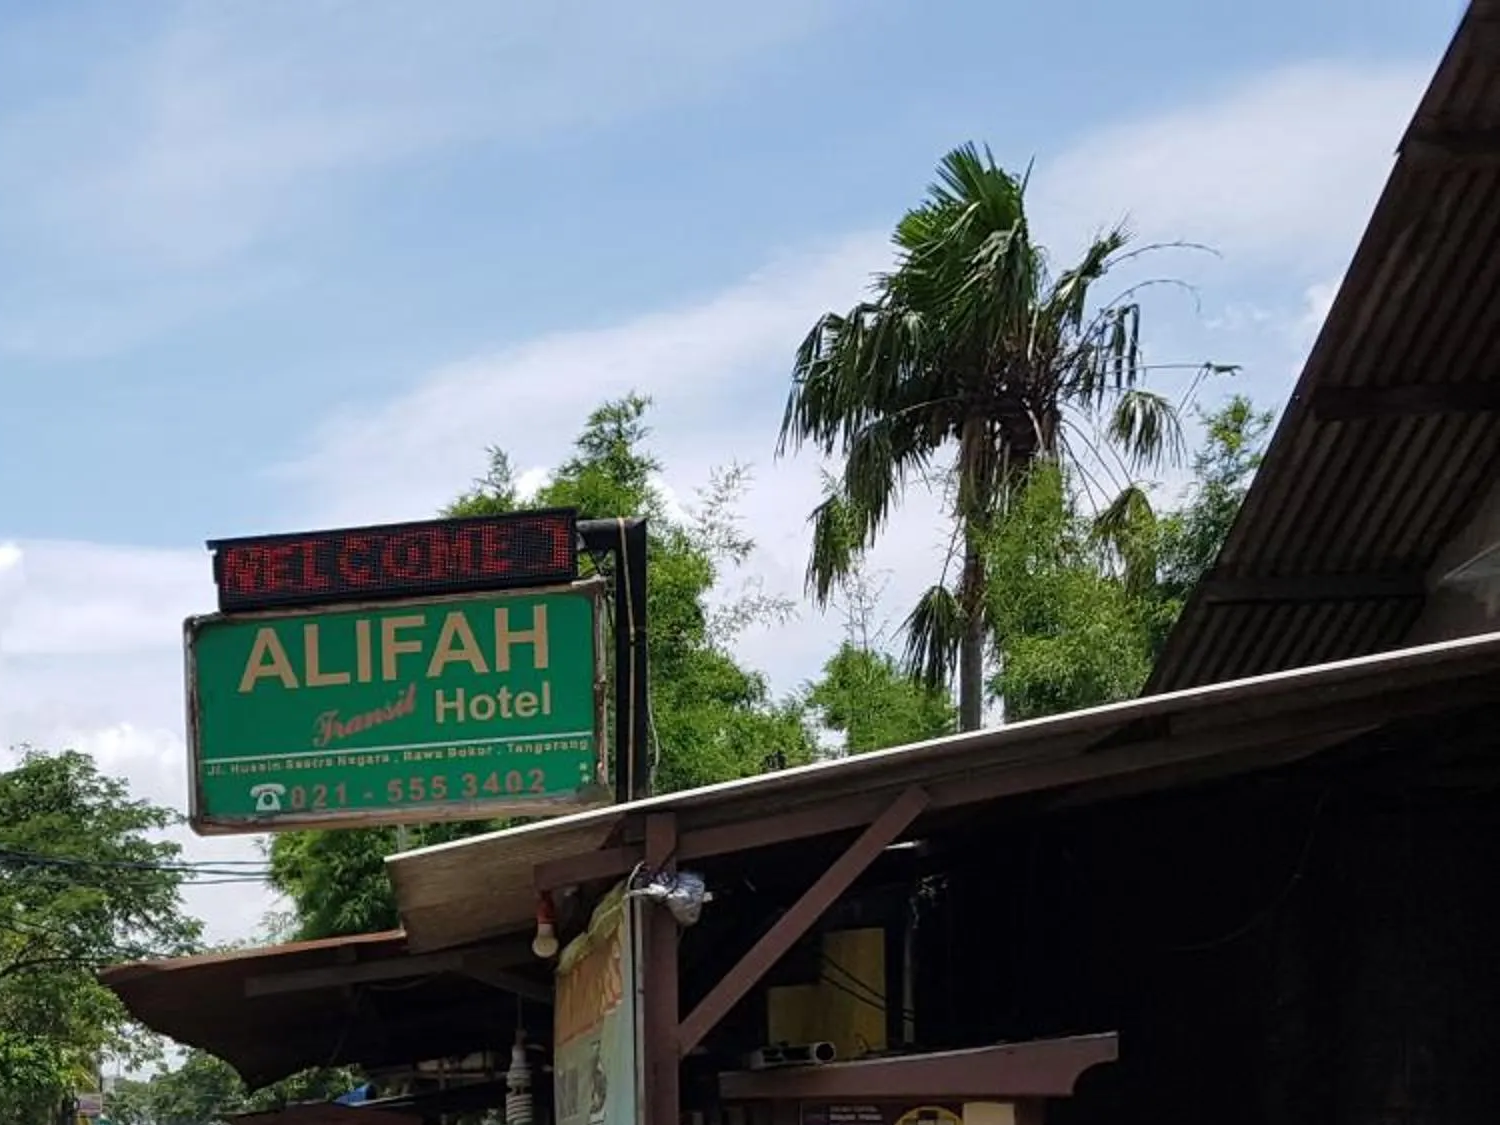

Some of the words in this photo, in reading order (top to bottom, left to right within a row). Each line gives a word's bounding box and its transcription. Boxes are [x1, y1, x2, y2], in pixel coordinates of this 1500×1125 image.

[224, 523, 510, 594] WELCOME
[238, 604, 550, 693] ALIFAH
[435, 681, 552, 724] Hotel
[506, 738, 589, 754] Tangerang
[290, 777, 350, 811] 021
[386, 777, 448, 803] 555
[462, 766, 547, 798] 3402
